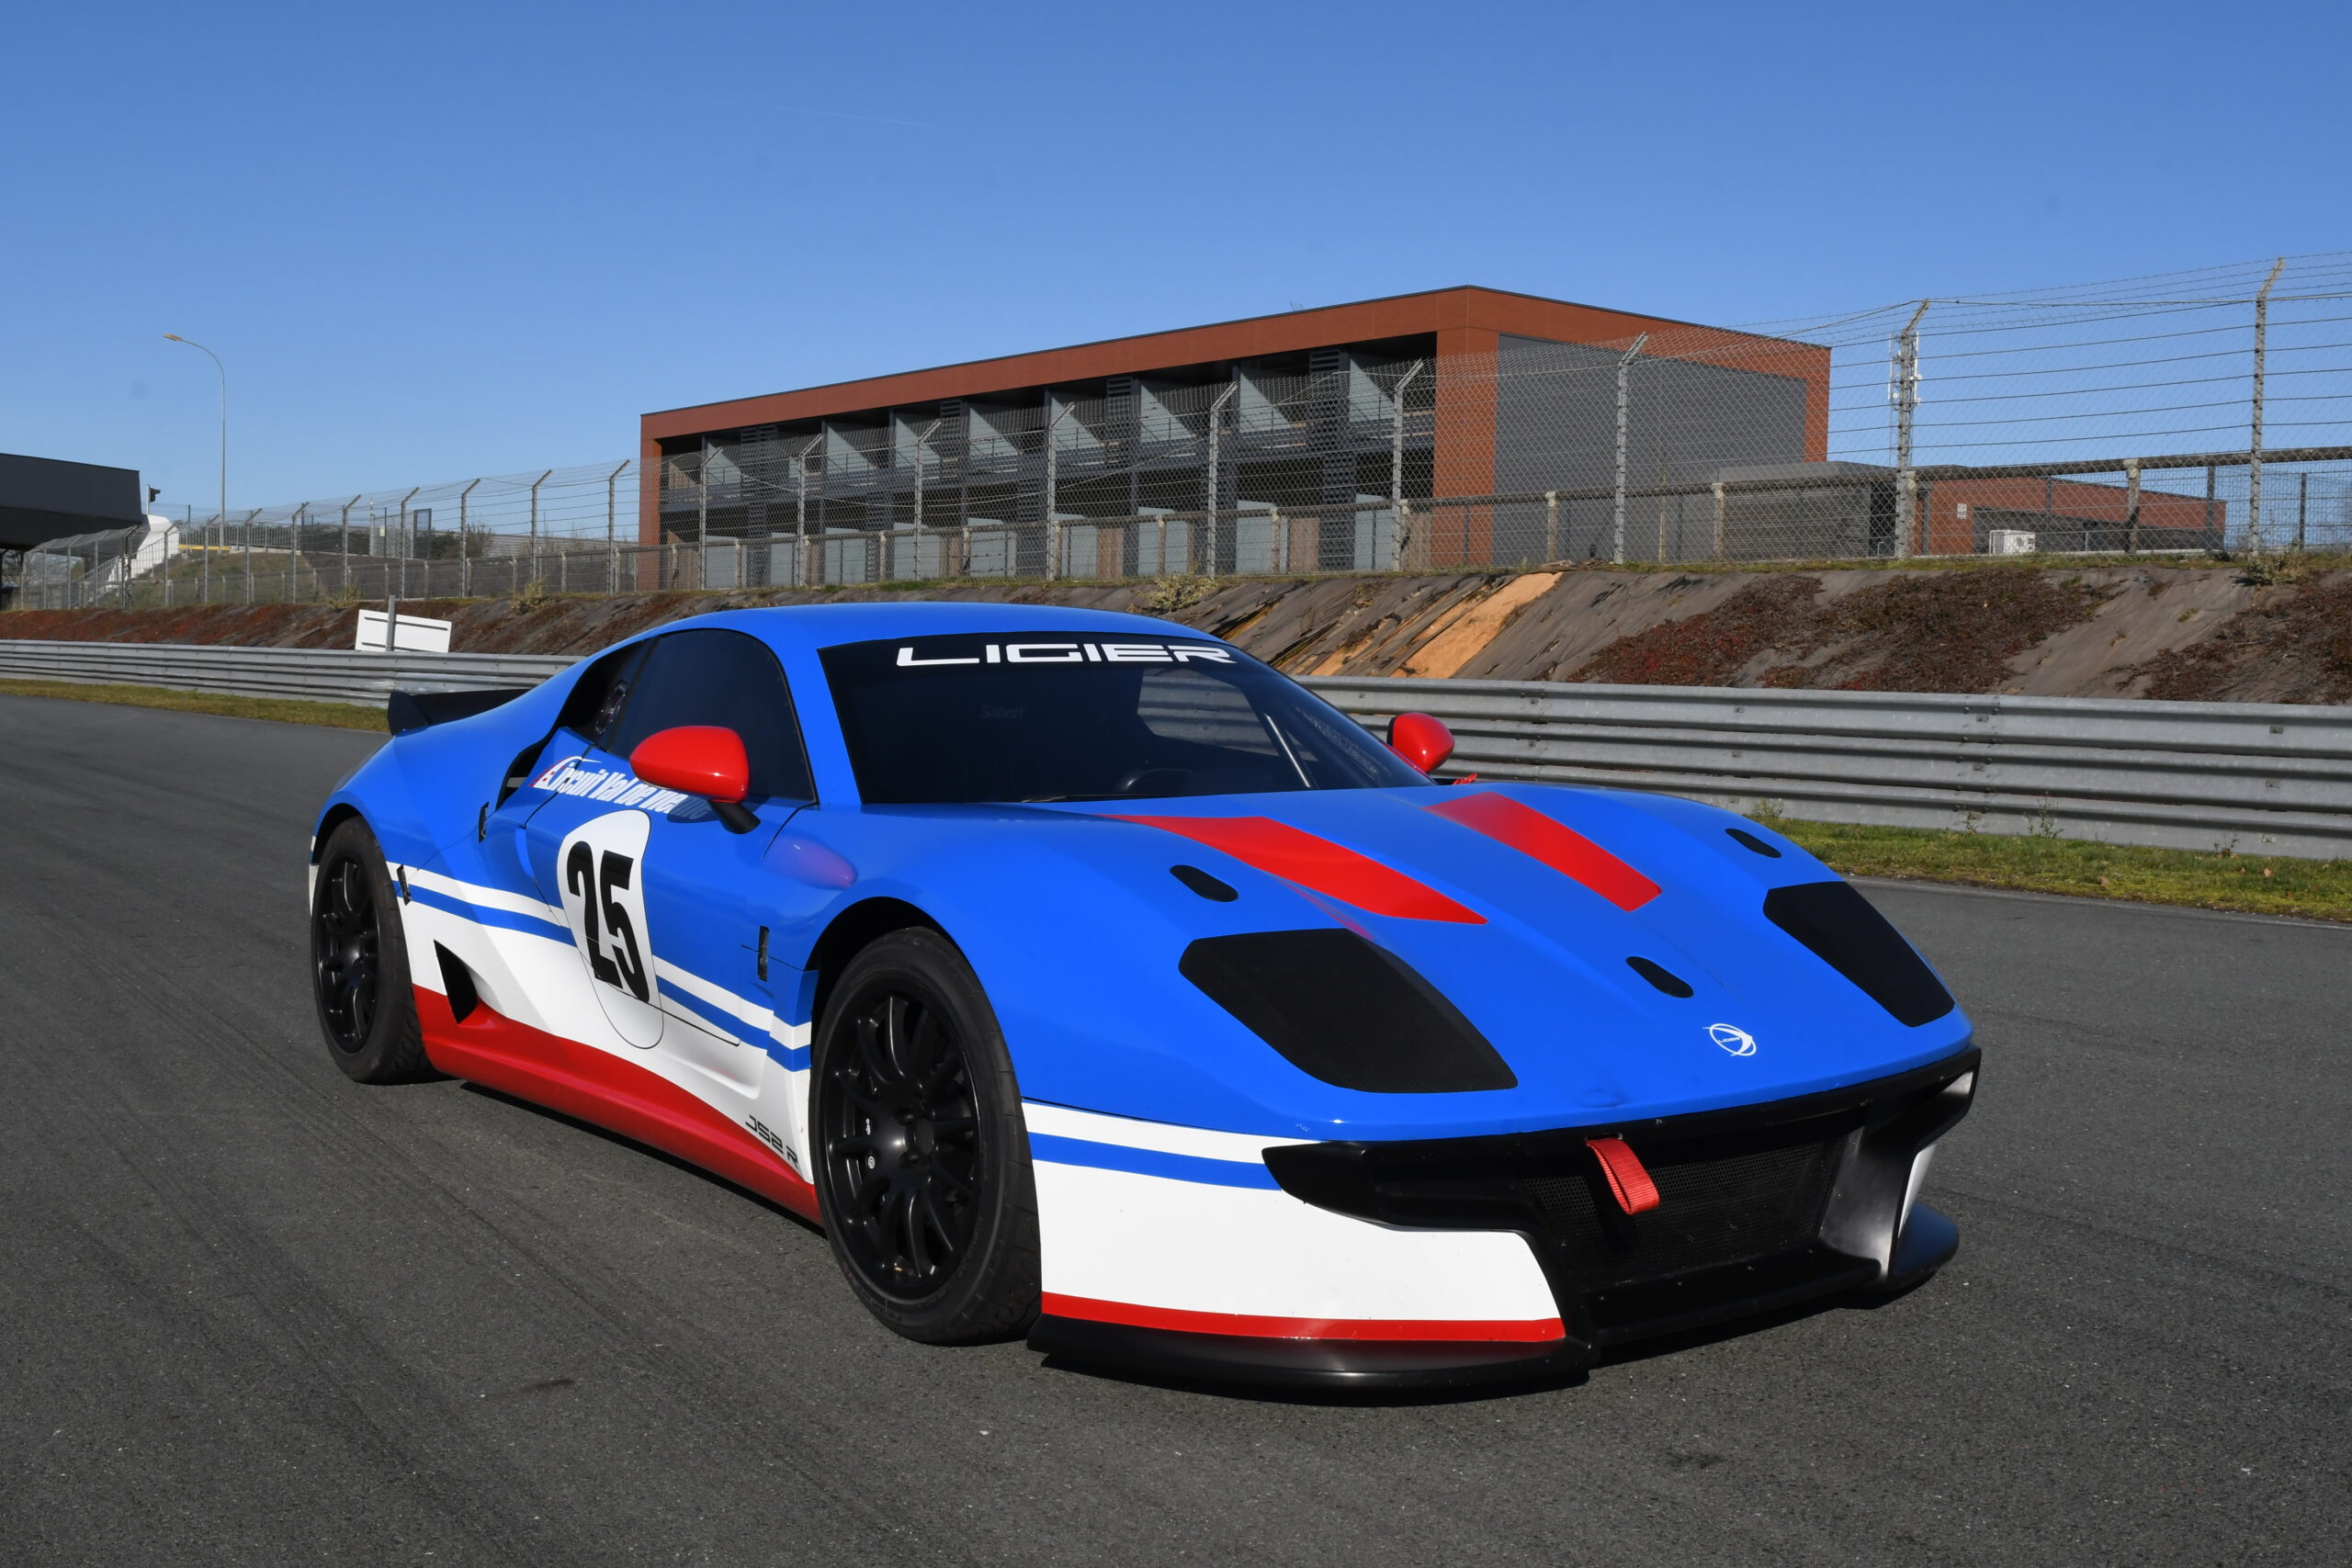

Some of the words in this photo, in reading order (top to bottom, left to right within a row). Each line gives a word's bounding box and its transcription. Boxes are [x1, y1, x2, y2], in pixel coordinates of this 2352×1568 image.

[896, 643, 1238, 667] LIGIER
[530, 756, 609, 796] Circuit
[588, 773, 640, 802] Val
[614, 781, 658, 807] de
[567, 840, 650, 1003] 25
[786, 1145, 799, 1168] R
